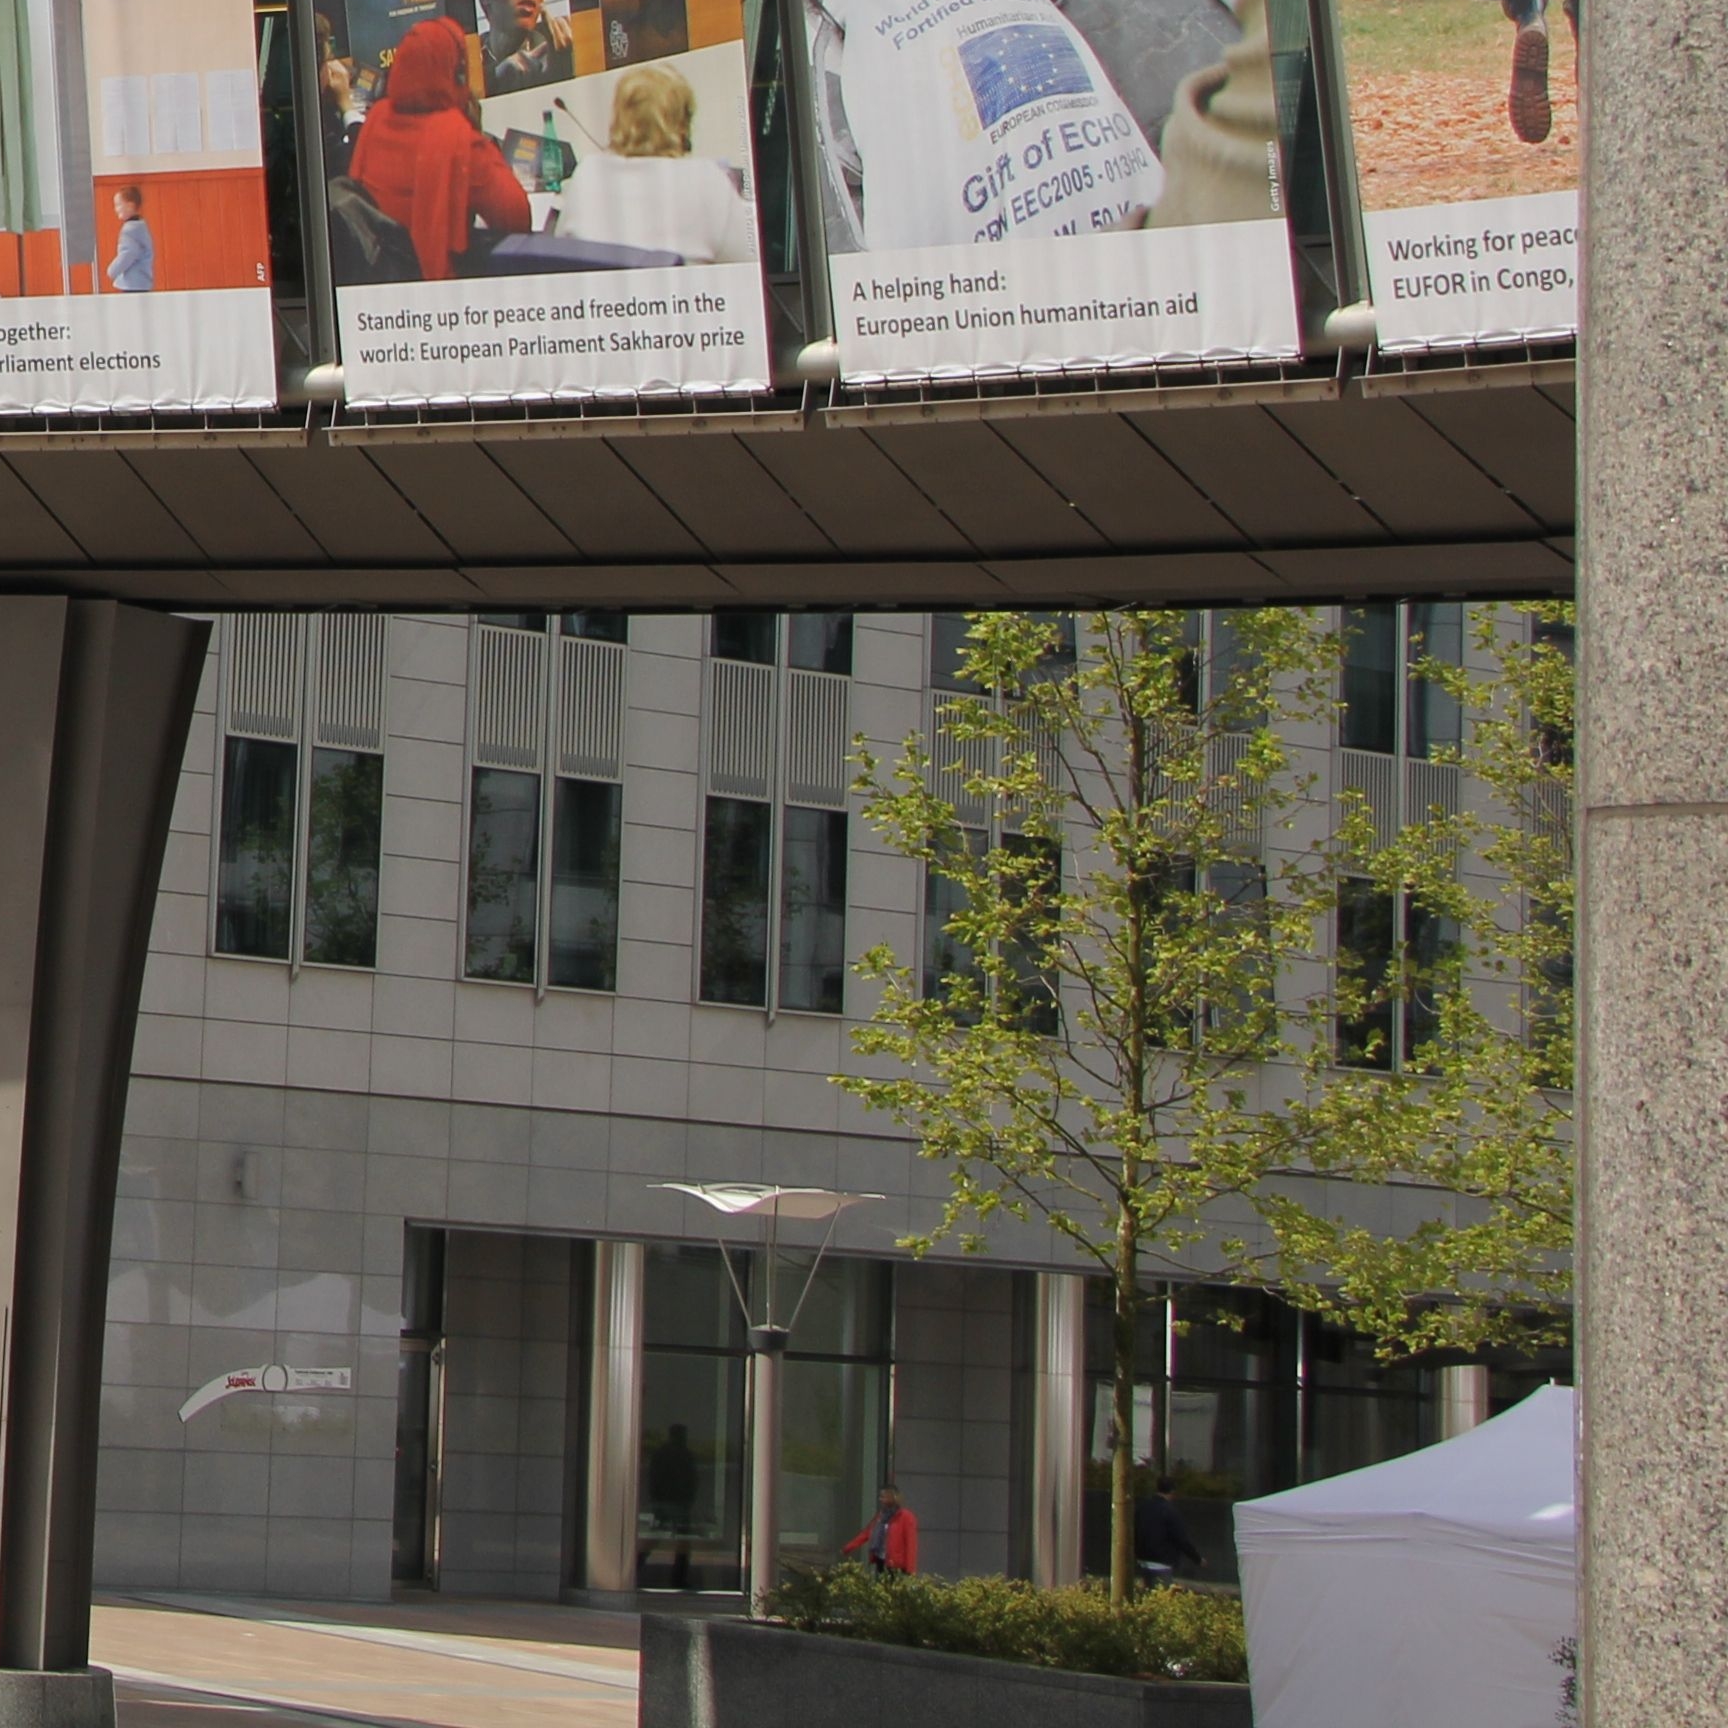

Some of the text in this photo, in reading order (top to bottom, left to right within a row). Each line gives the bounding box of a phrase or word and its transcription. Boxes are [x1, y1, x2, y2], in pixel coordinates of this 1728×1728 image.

[955, 12, 1038, 40] Humanitarian
[989, 104, 1046, 145] EUROPEAN
[962, 112, 1132, 214] Gift of ECHO
[1266, 140, 1281, 212] Getty Images
[1011, 164, 1094, 225] EEC2005
[1104, 147, 1149, 183] 013HQ
[1388, 235, 1478, 261] Working
[1483, 230, 1515, 252] for
[256, 262, 266, 282] AFP
[853, 270, 1006, 302] A helping hand:
[1393, 268, 1573, 299] EUFOR in Congo,
[358, 293, 725, 332] Standing up for peace and freedom in the
[856, 292, 1198, 338] European Union humanitarian aid
[80, 351, 160, 370] elections
[360, 326, 744, 363] world: European Parliament Sakharov prize
